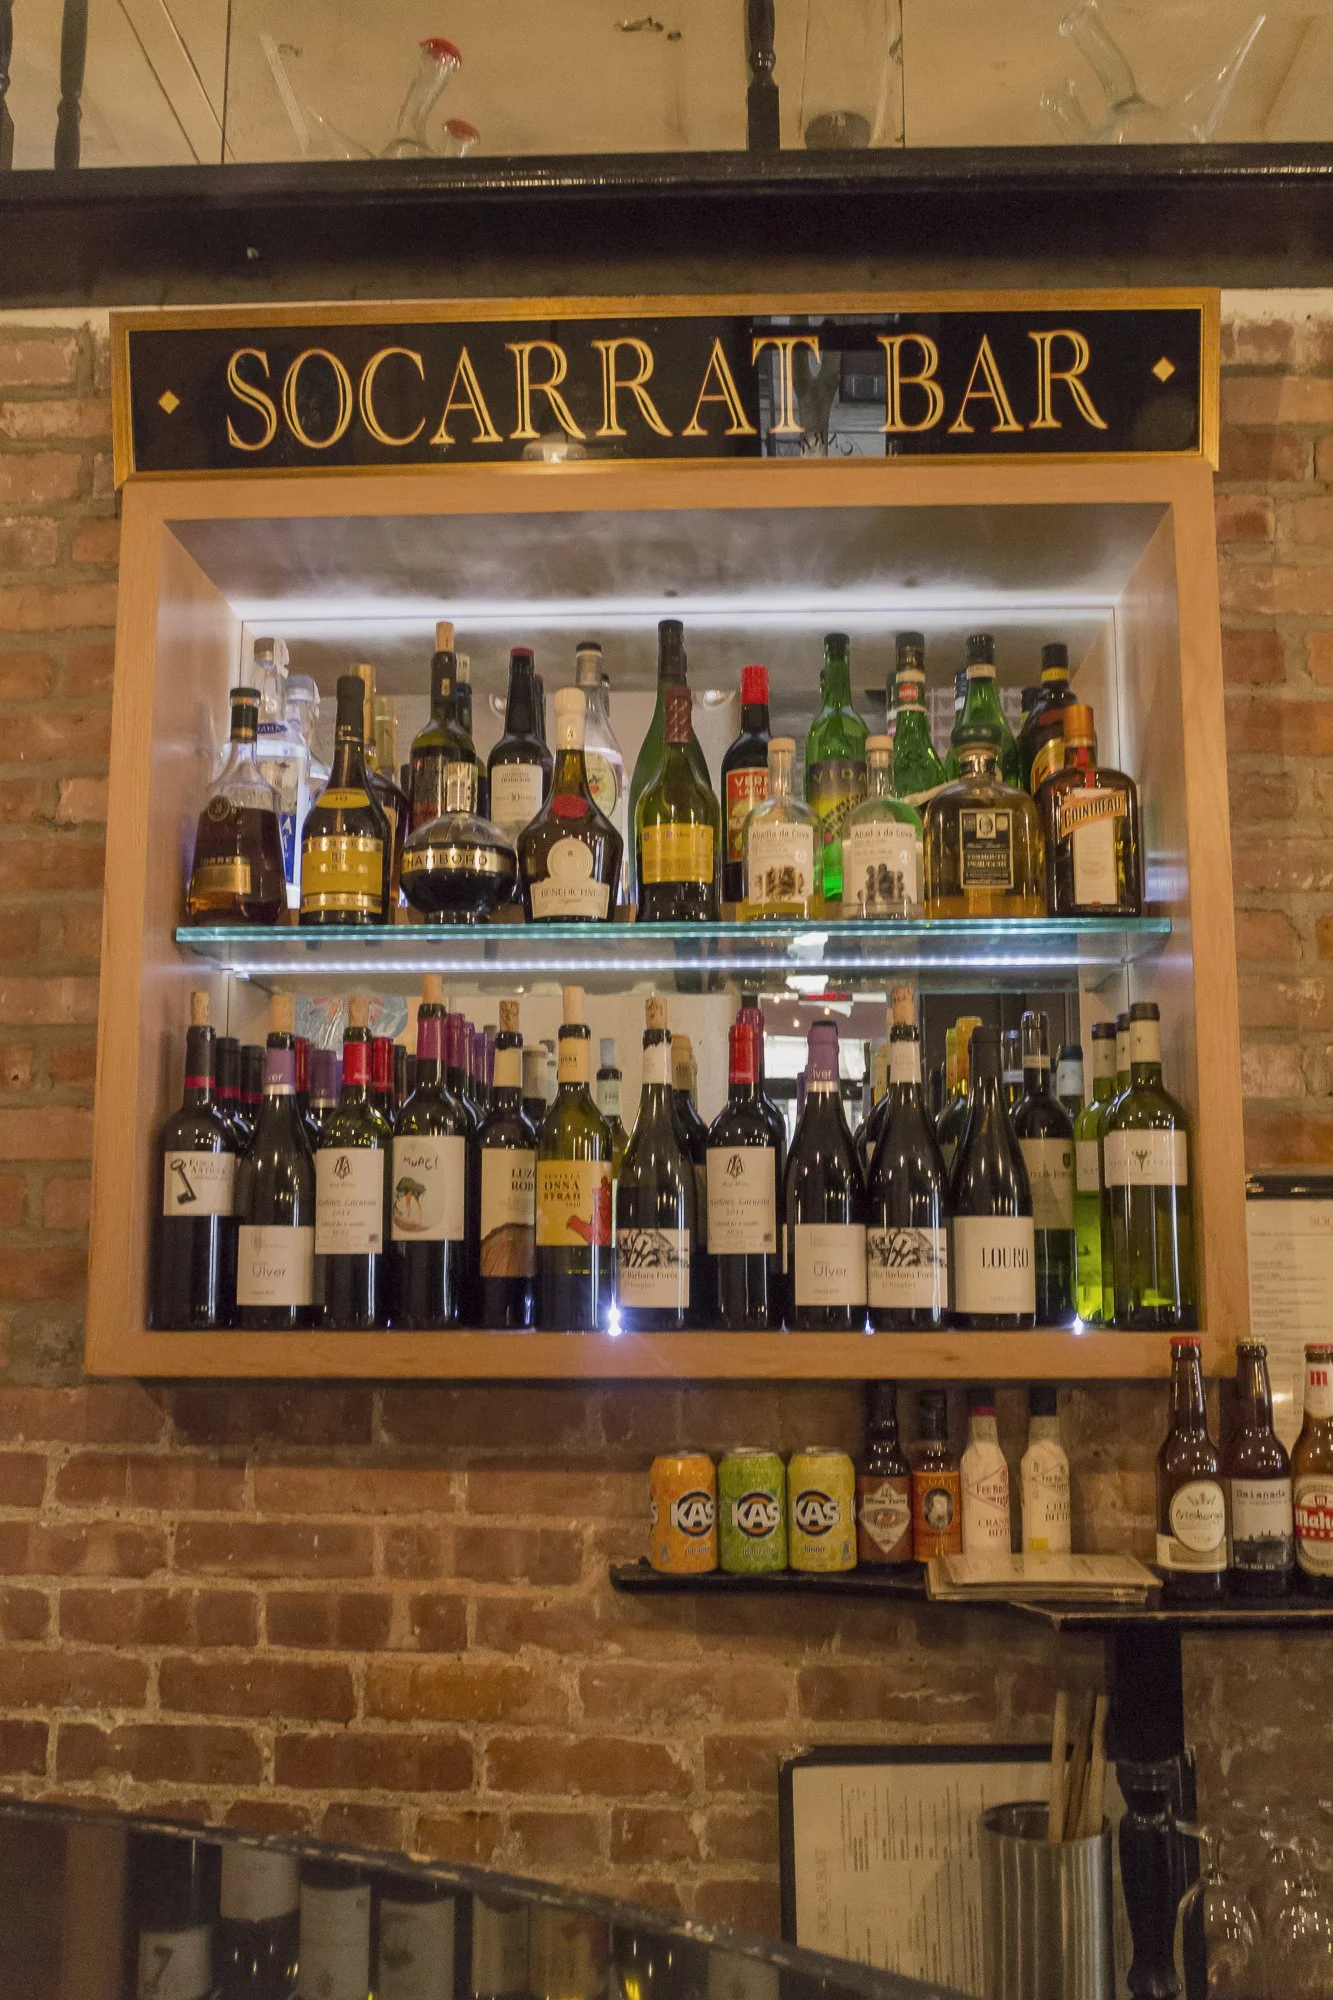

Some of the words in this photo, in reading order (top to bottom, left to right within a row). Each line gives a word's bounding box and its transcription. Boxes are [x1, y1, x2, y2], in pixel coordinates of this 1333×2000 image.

[226, 335, 820, 452] SOCARRAT
[879, 329, 1109, 434] BAR
[403, 853, 488, 868] HAMBORD
[544, 1181, 579, 1190] OSSA
[981, 1247, 1029, 1269] LOURO
[671, 1501, 716, 1528] KAS
[731, 1501, 781, 1528] KAS
[792, 1500, 841, 1528] KAS
